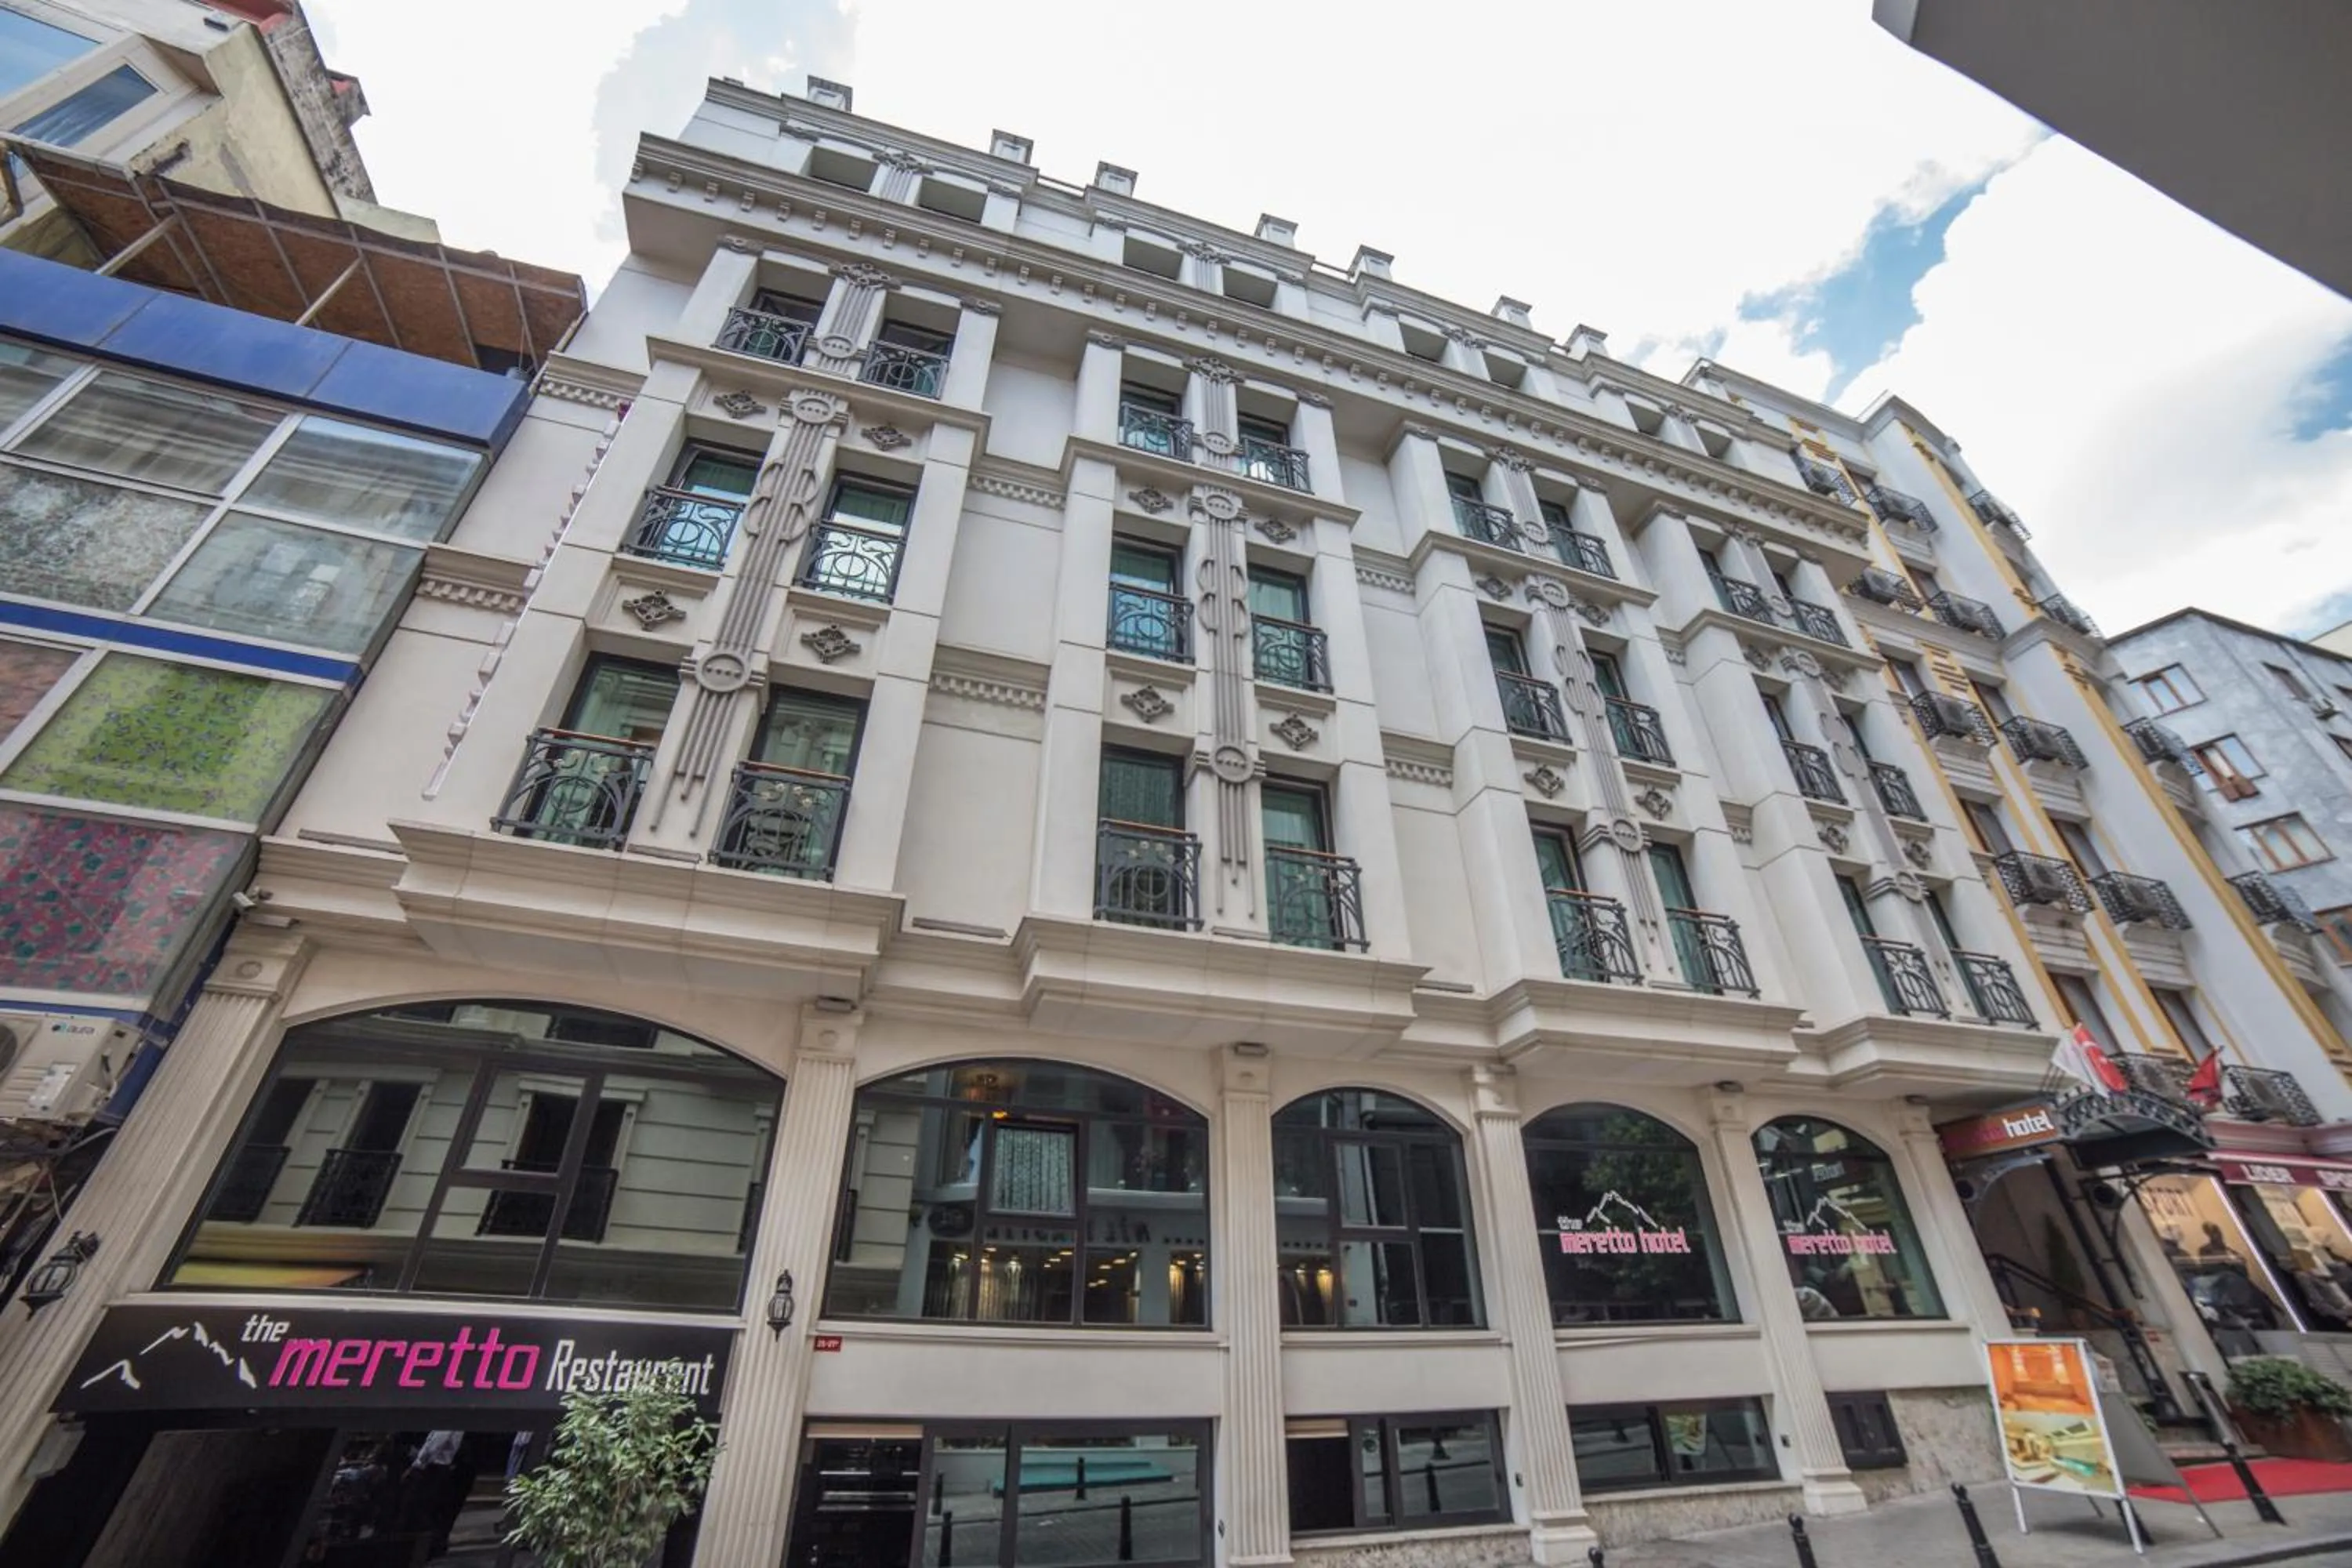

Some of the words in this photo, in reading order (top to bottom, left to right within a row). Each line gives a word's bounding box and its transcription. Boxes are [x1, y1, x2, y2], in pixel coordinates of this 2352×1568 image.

[2002, 1109, 2054, 1138] hotel
[1559, 1226, 1638, 1254] meretto
[1639, 1226, 1691, 1254] hotel
[241, 1314, 291, 1342] the
[267, 1327, 540, 1389] meretto
[546, 1339, 714, 1396] Restaurant
